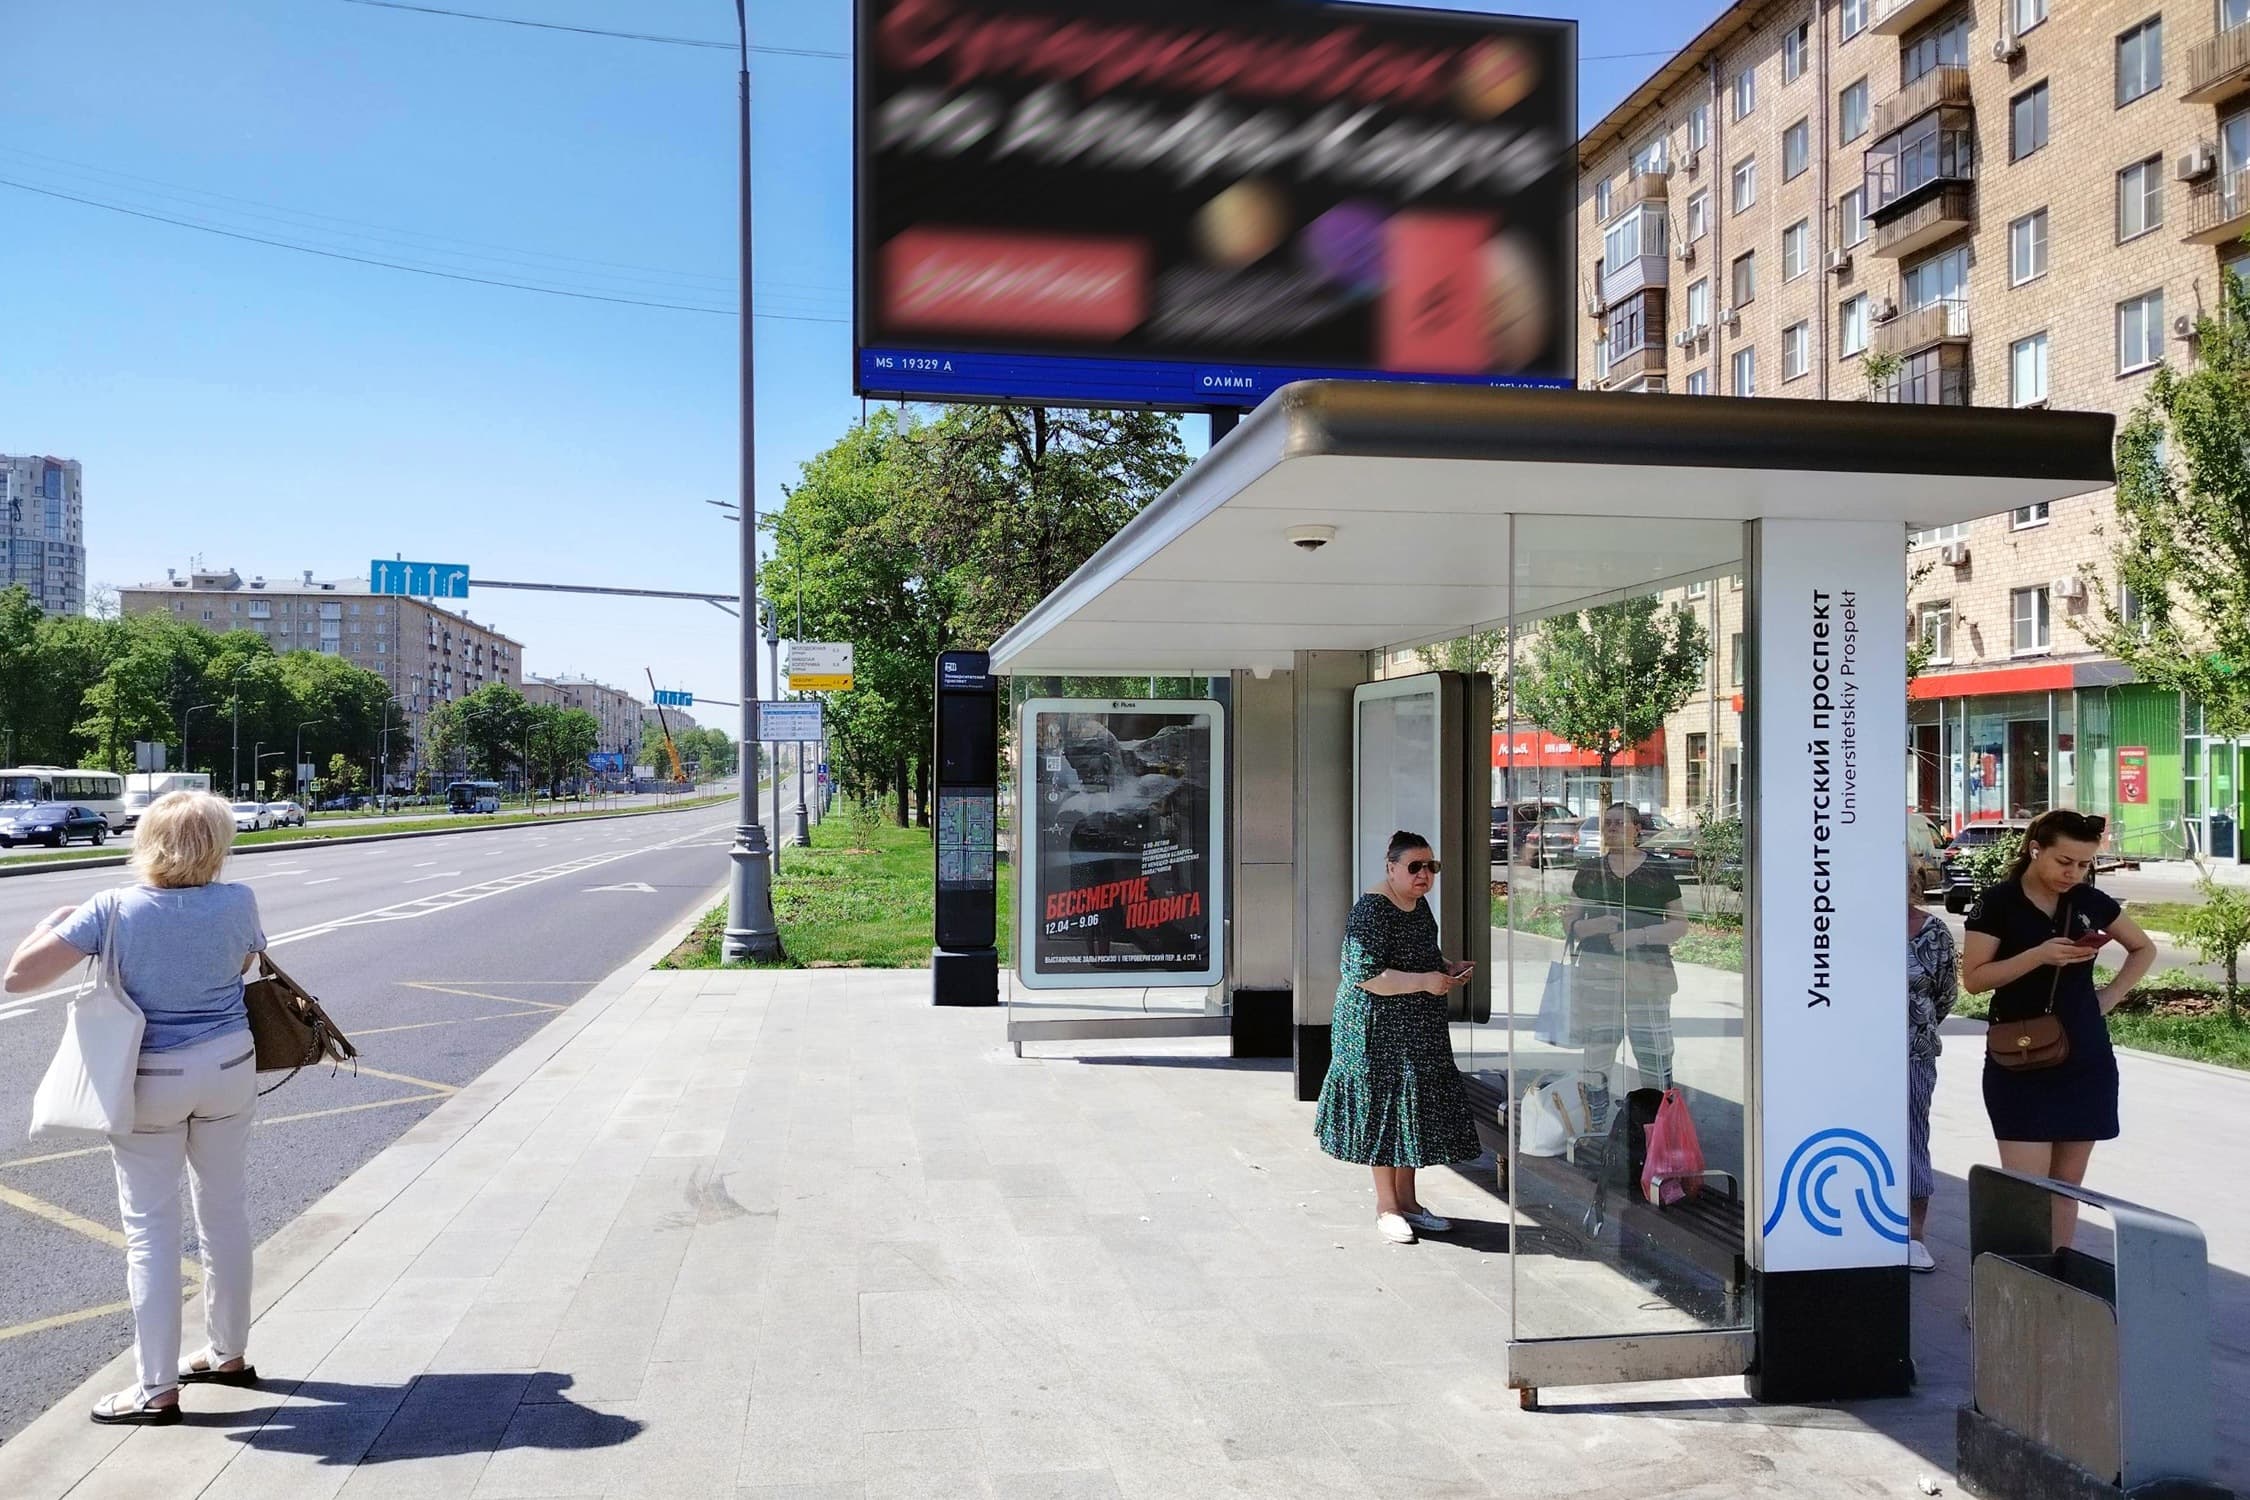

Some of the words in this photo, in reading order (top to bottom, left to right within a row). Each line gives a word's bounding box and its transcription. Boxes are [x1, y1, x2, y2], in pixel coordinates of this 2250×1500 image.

[876, 357, 894, 368] MS
[902, 358, 938, 370] 19329
[943, 360, 952, 371] A
[1203, 376, 1252, 387] ОЛИМП
[1839, 589, 1859, 675] Prospekt
[1812, 589, 1835, 729] проспект
[1839, 682, 1859, 824] Universitetskiy
[1807, 741, 1835, 1008] Университетский
[1045, 876, 1150, 920] БЕССМЕРТИЕ
[1125, 891, 1200, 929] ПОДВИГА
[1045, 919, 1069, 935] 12.04
[1079, 914, 1099, 928] 9.06
